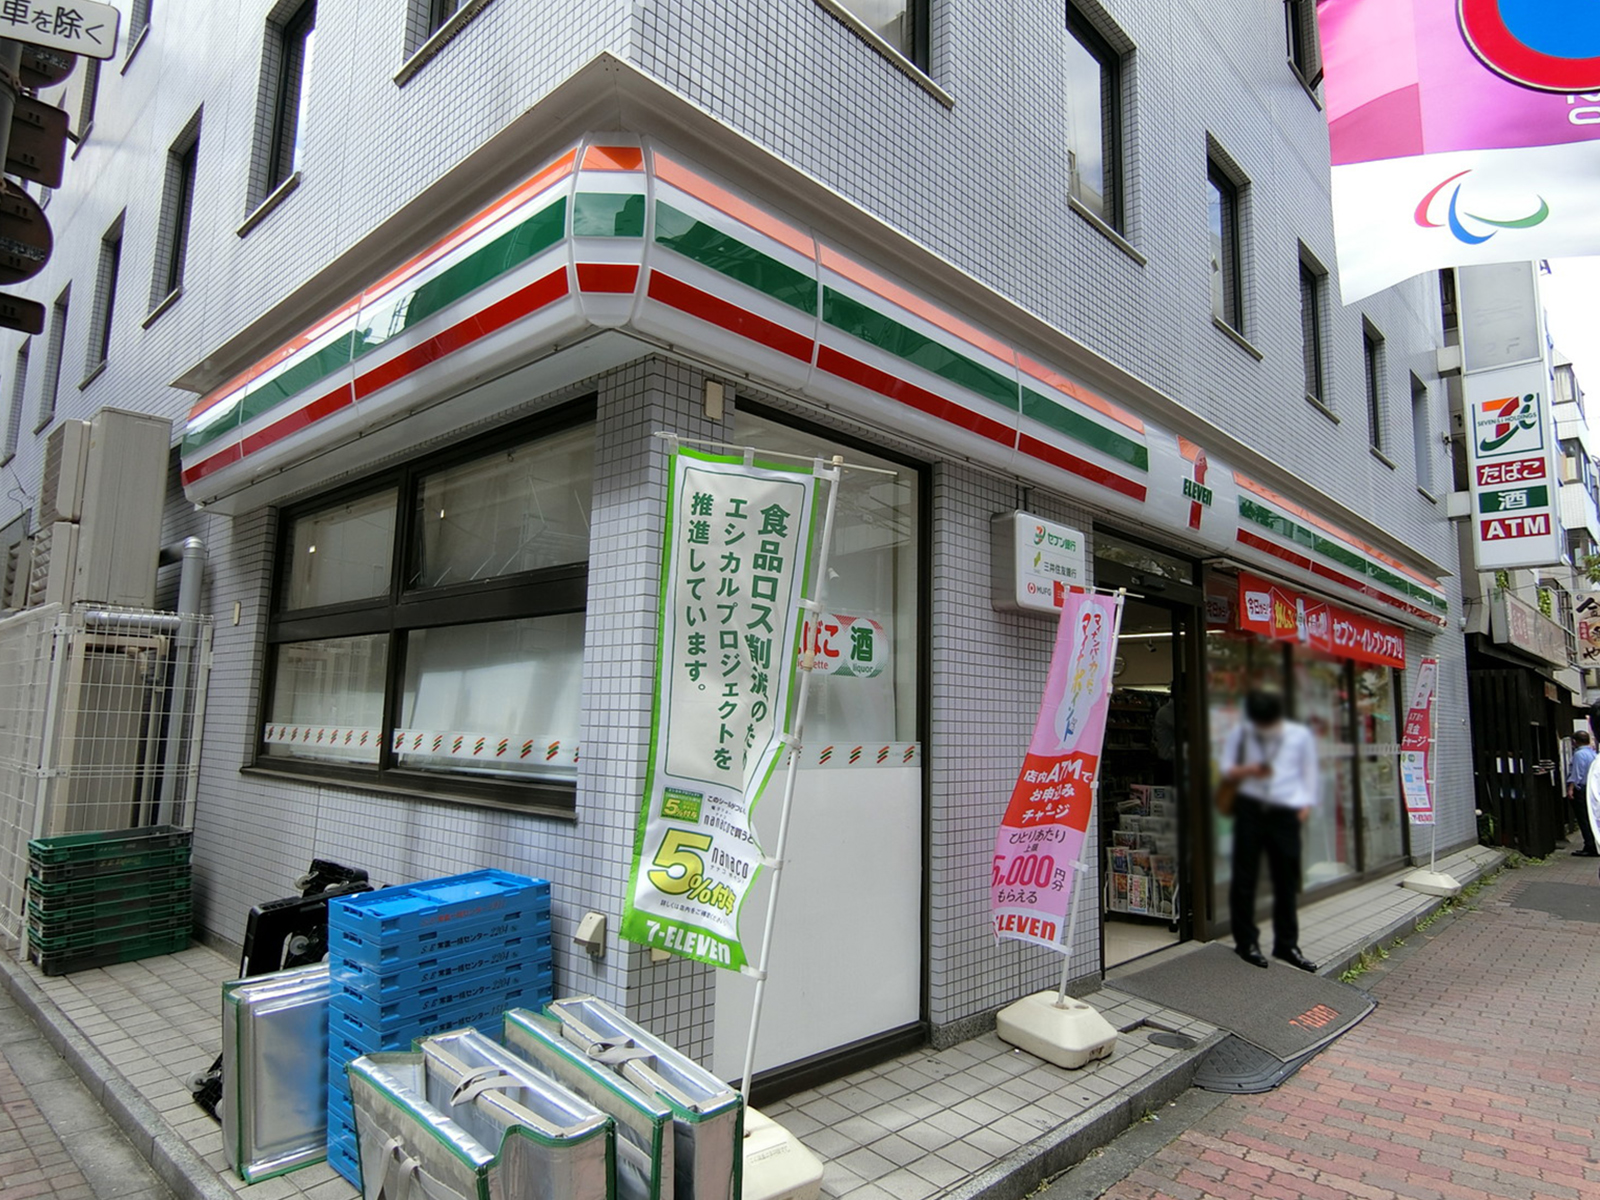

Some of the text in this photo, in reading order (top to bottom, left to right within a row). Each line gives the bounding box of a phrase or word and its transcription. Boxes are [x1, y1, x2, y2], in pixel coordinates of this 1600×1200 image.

[1480, 460, 1542, 485] たばこ
[1498, 489, 1527, 511] 酒
[1486, 515, 1546, 539] ATM
[1047, 532, 1076, 552] セブン銀行
[1044, 561, 1077, 579] 三井住友銀行
[684, 492, 715, 691] 推進しています。
[1036, 586, 1052, 597] MUFG
[713, 498, 748, 771] エシカルプロジェクトを
[797, 620, 840, 658] ばこ
[850, 625, 874, 662] 酒
[852, 663, 874, 674] liquor
[1023, 758, 1093, 783] 店内ATMで
[1029, 783, 1076, 803] お申込み
[1021, 803, 1071, 824] チャージ
[1008, 828, 1066, 845] ひとりあたり
[711, 847, 749, 879] nanaco
[997, 888, 1038, 904] もらえる
